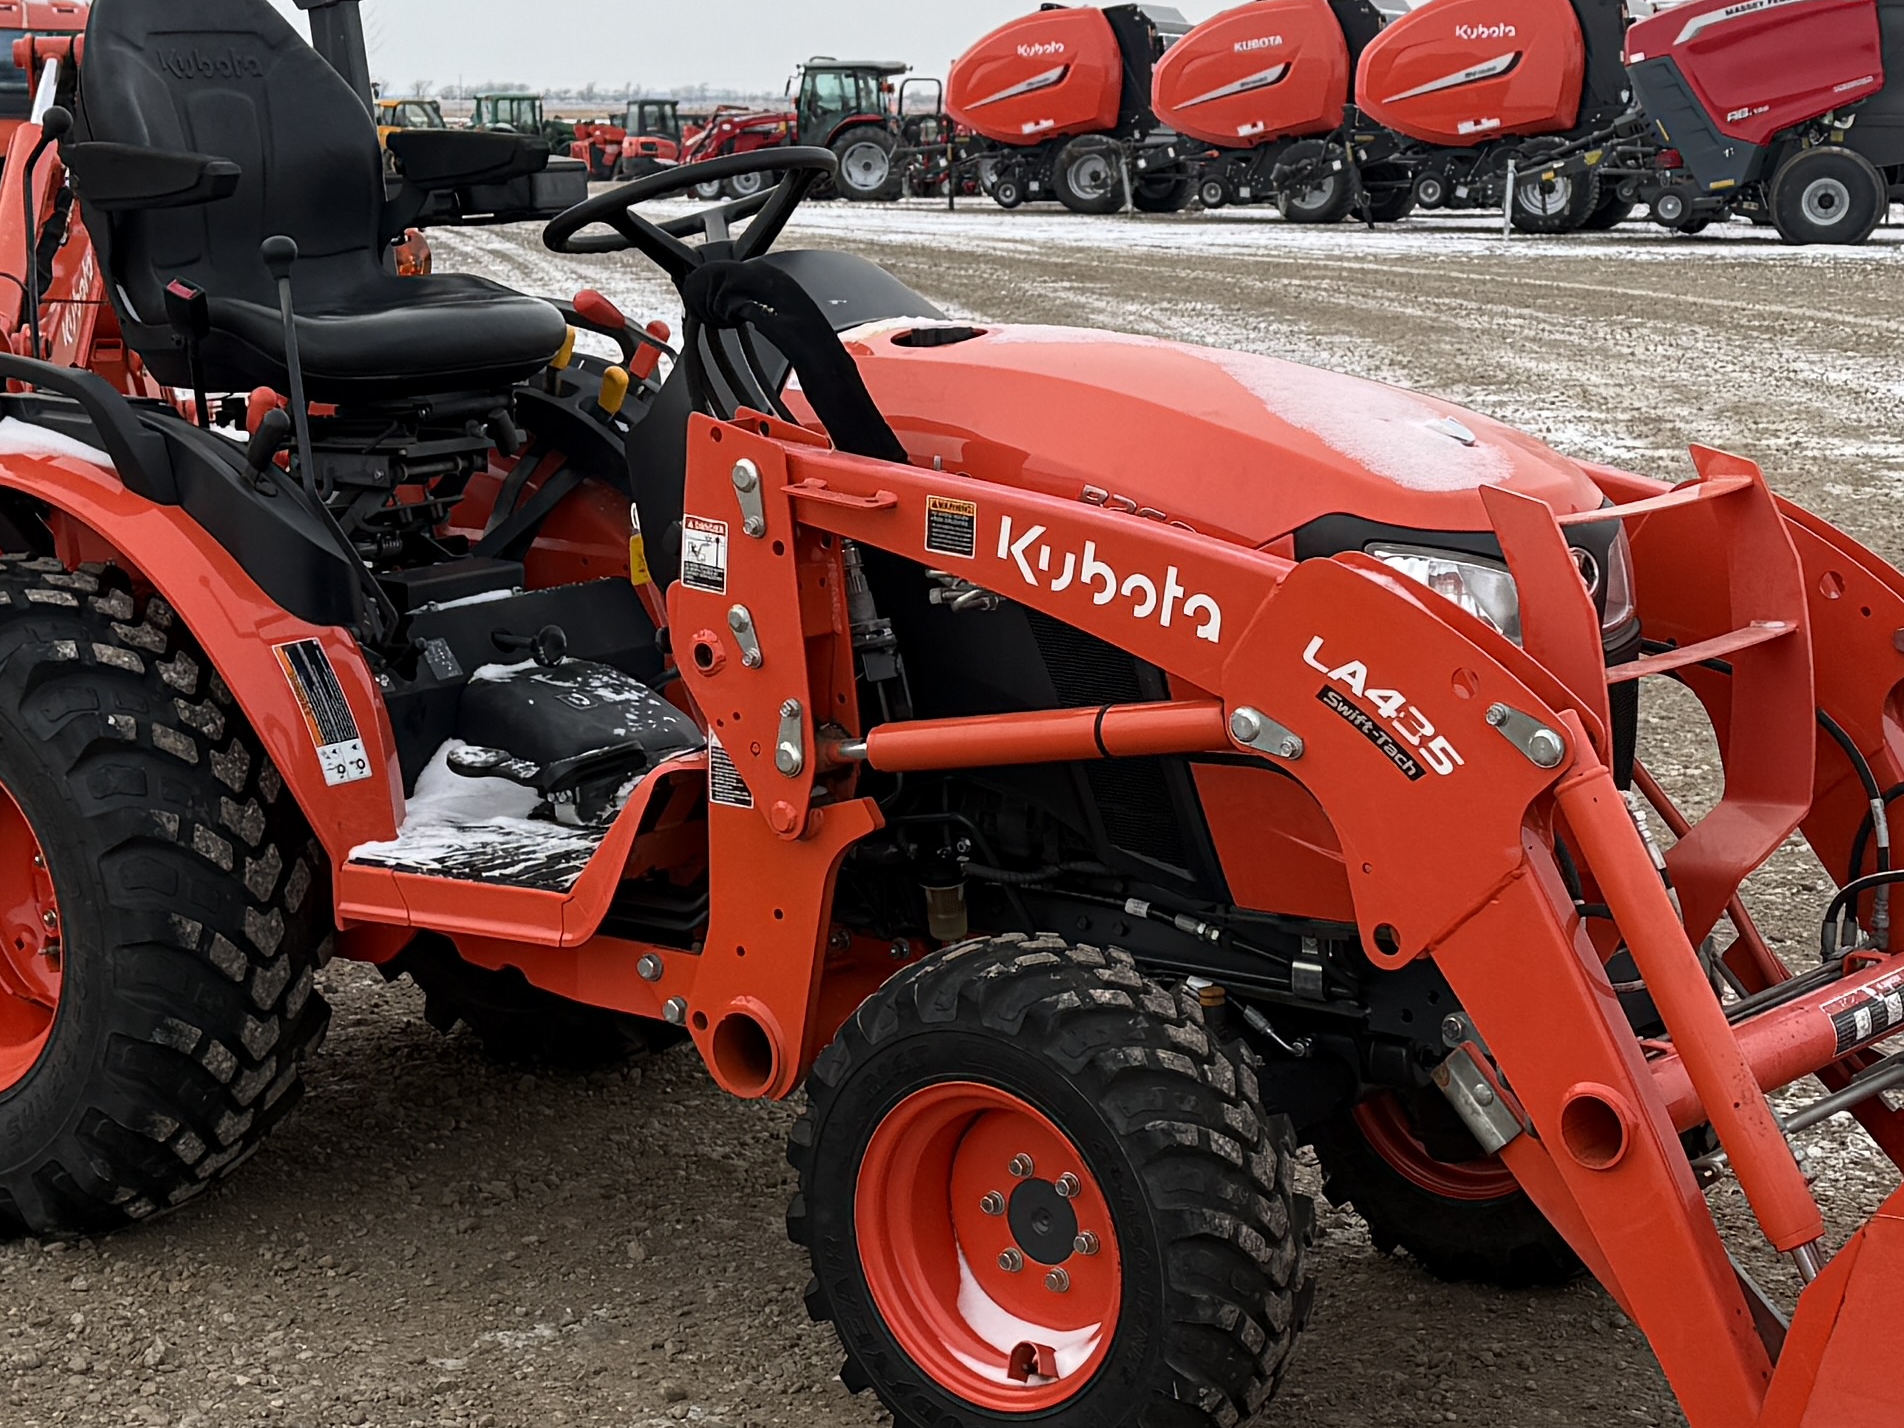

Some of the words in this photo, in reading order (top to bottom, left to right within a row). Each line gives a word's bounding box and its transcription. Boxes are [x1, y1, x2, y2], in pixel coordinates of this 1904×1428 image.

[1724, 1, 1764, 15] MASSEY
[1233, 35, 1283, 52] KUBOTA
[1455, 22, 1516, 40] Kubota
[156, 47, 266, 80] Kubota
[1017, 41, 1065, 56] Kubota
[61, 254, 94, 347] Kubota
[997, 515, 1222, 644] Kubota
[1302, 635, 1465, 776] LA435
[1322, 690, 1417, 776] Swift-Tach
